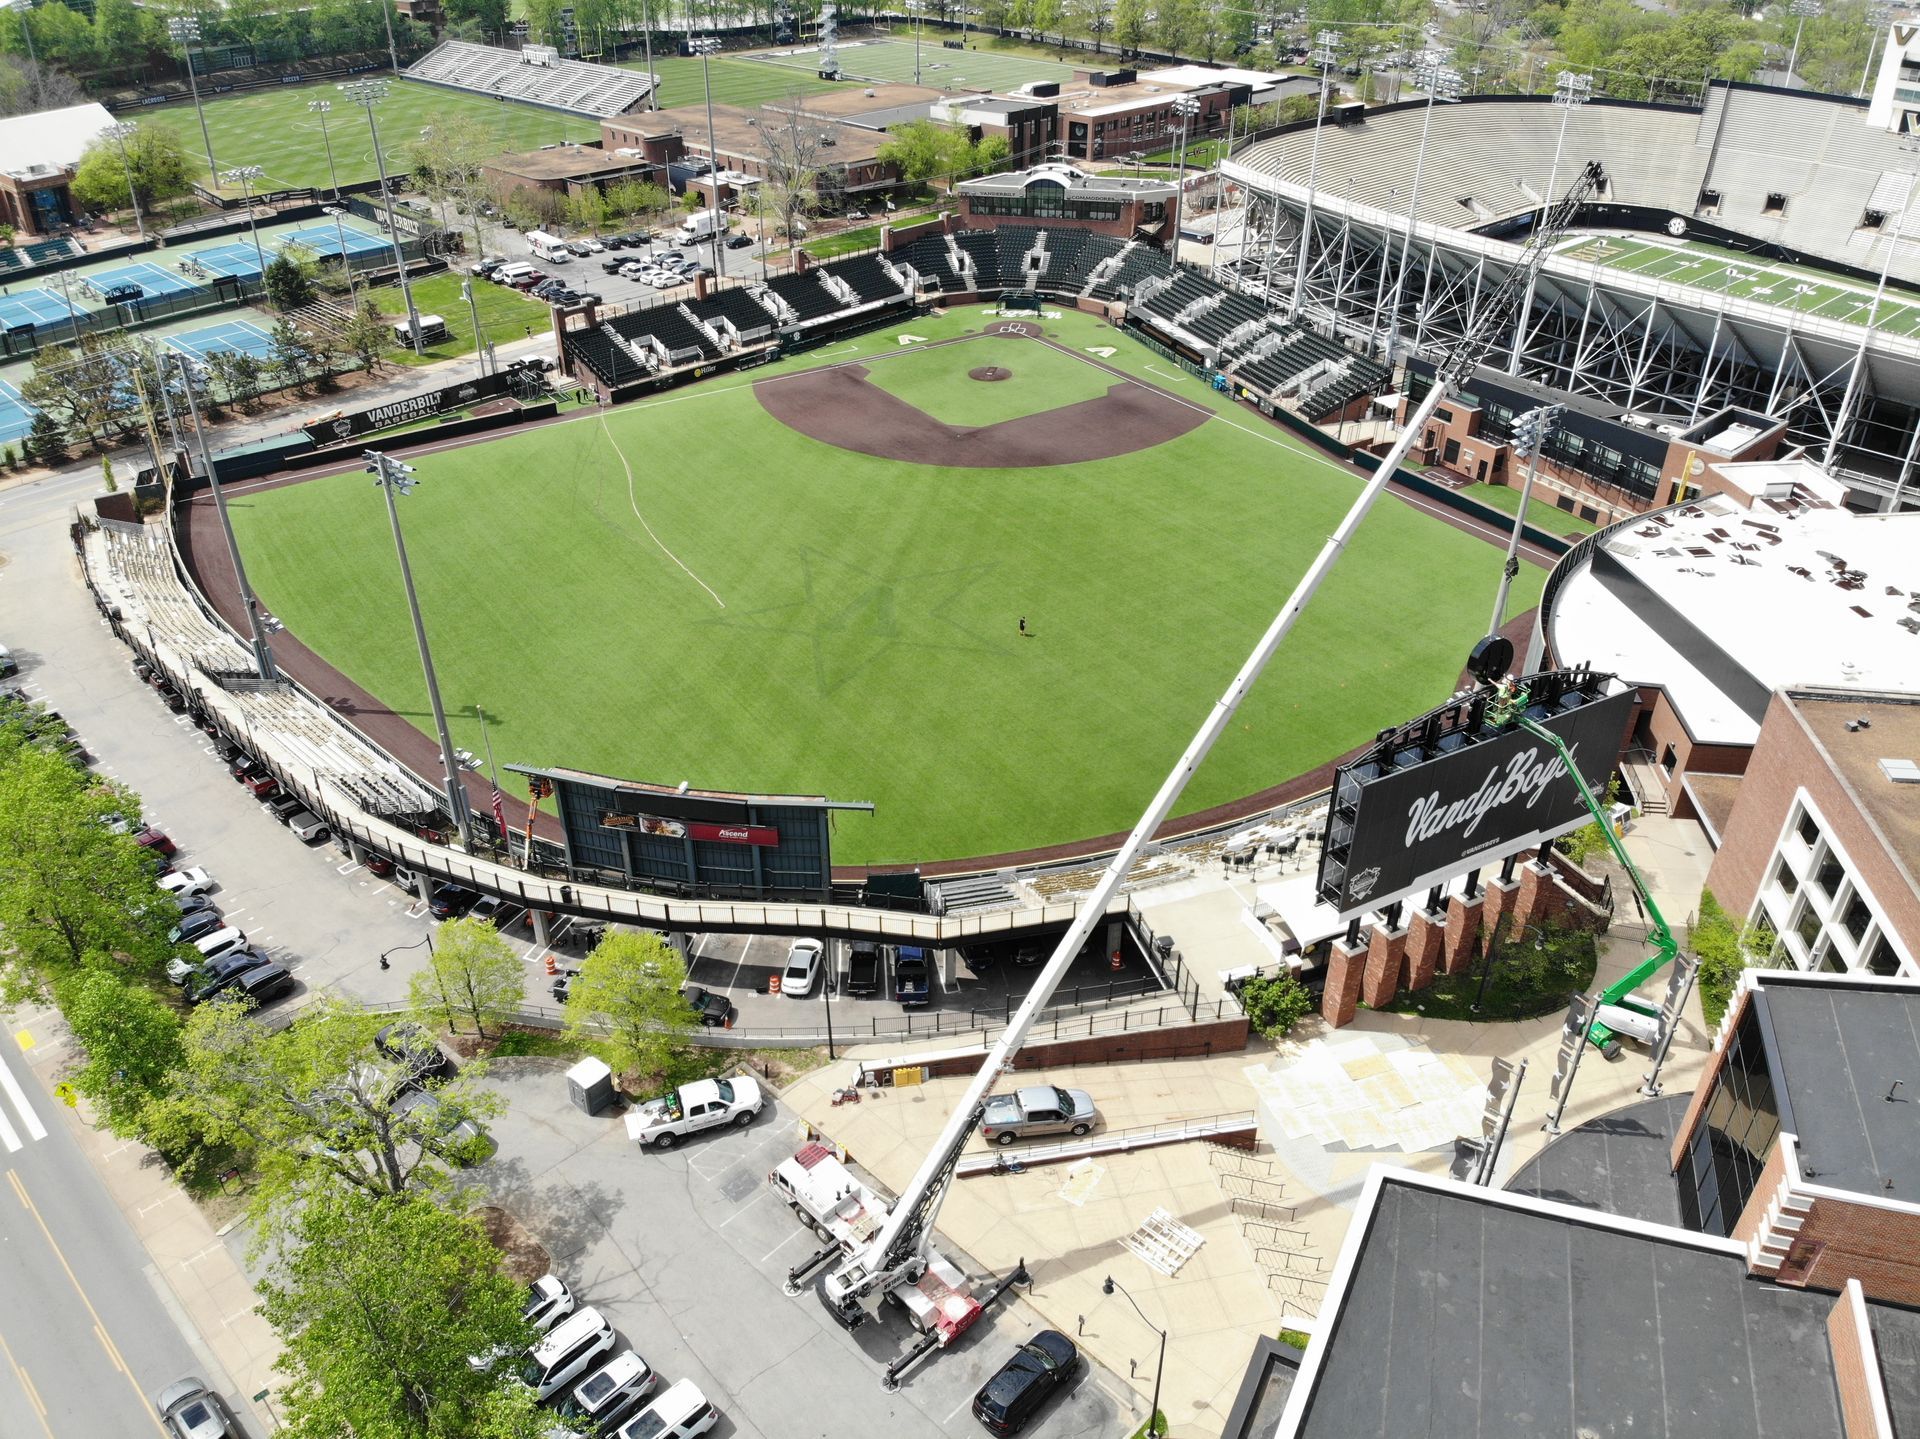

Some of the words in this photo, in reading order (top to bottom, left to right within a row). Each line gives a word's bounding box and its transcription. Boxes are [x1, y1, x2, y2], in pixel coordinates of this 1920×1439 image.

[1893, 25, 1919, 46] V
[141, 95, 167, 106] LACROSSE
[866, 167, 878, 180] V
[527, 235, 542, 249] FedEx
[701, 365, 717, 374] Hiller
[367, 391, 442, 423] VANDERBILT
[375, 406, 437, 428] BASEBALL
[719, 828, 749, 838] Ascend
